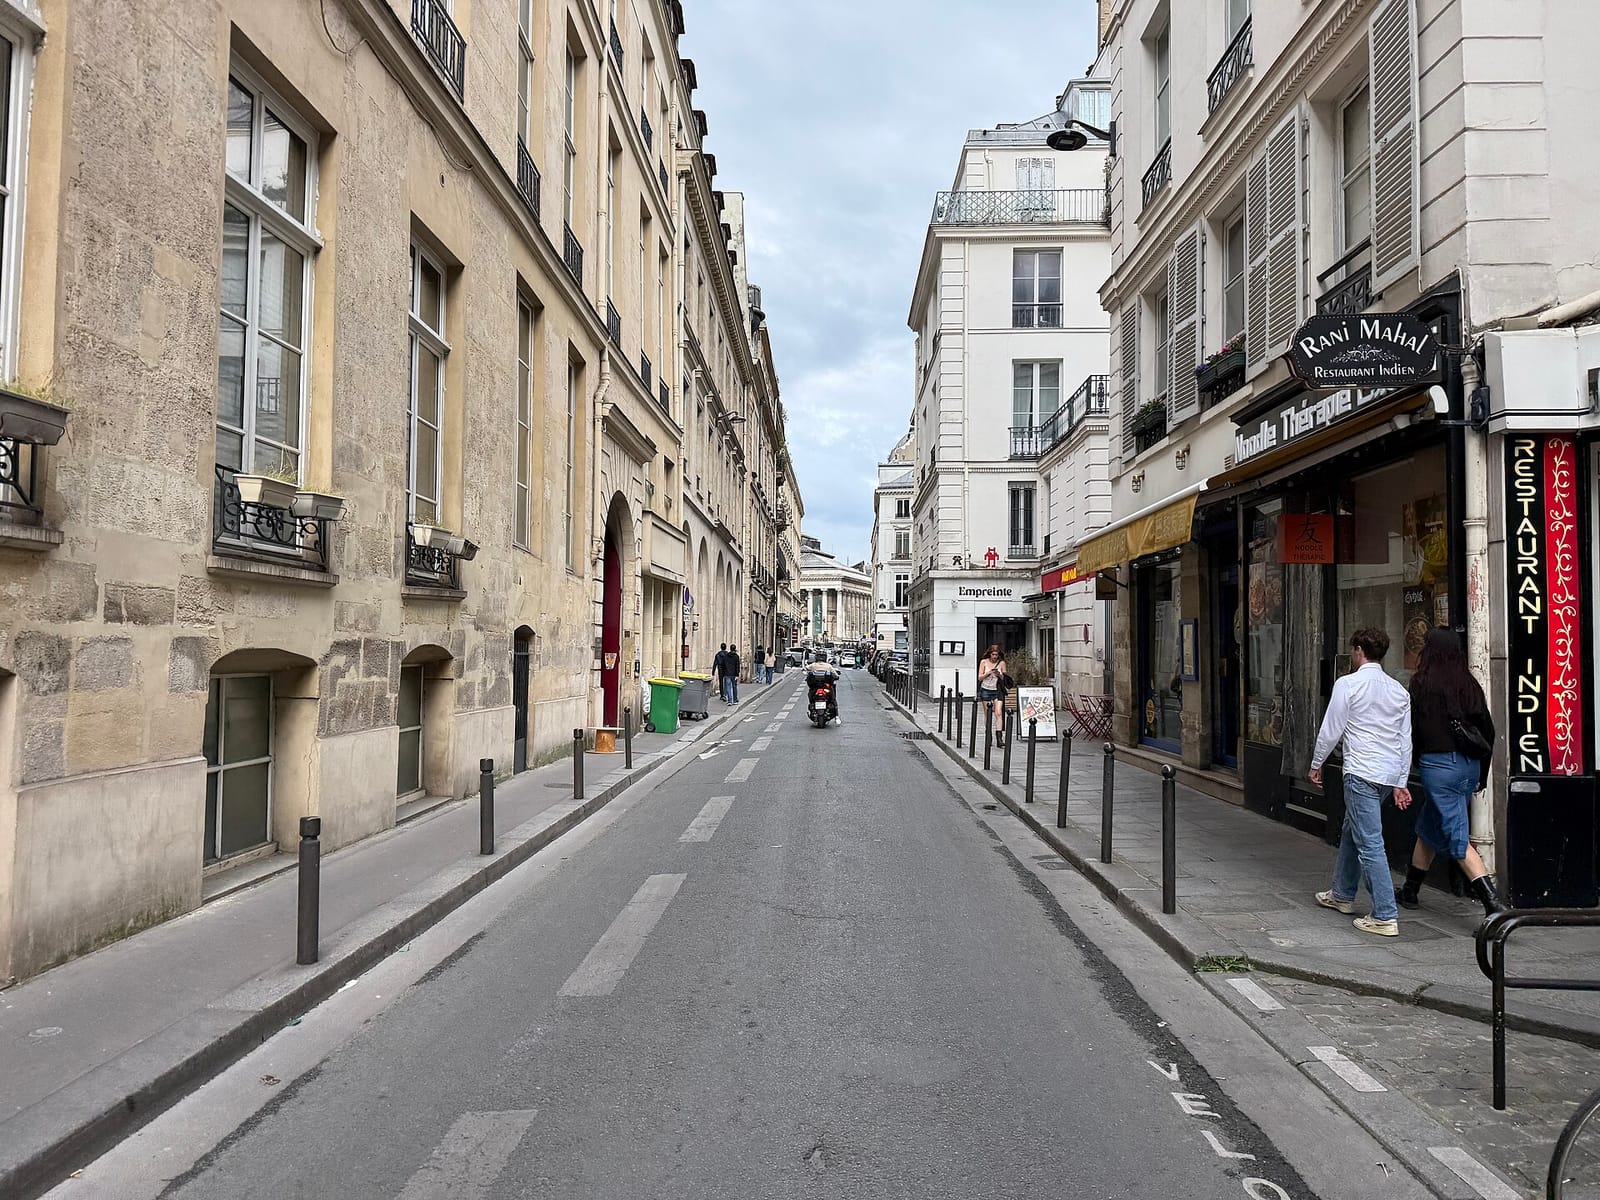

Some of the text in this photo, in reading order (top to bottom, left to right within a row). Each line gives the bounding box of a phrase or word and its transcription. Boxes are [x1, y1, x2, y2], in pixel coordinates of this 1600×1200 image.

[1234, 389, 1351, 464] Noodle Thérapie
[958, 586, 1013, 598] Empreinte
[1514, 439, 1543, 773] RESTAURANT INDIEN
